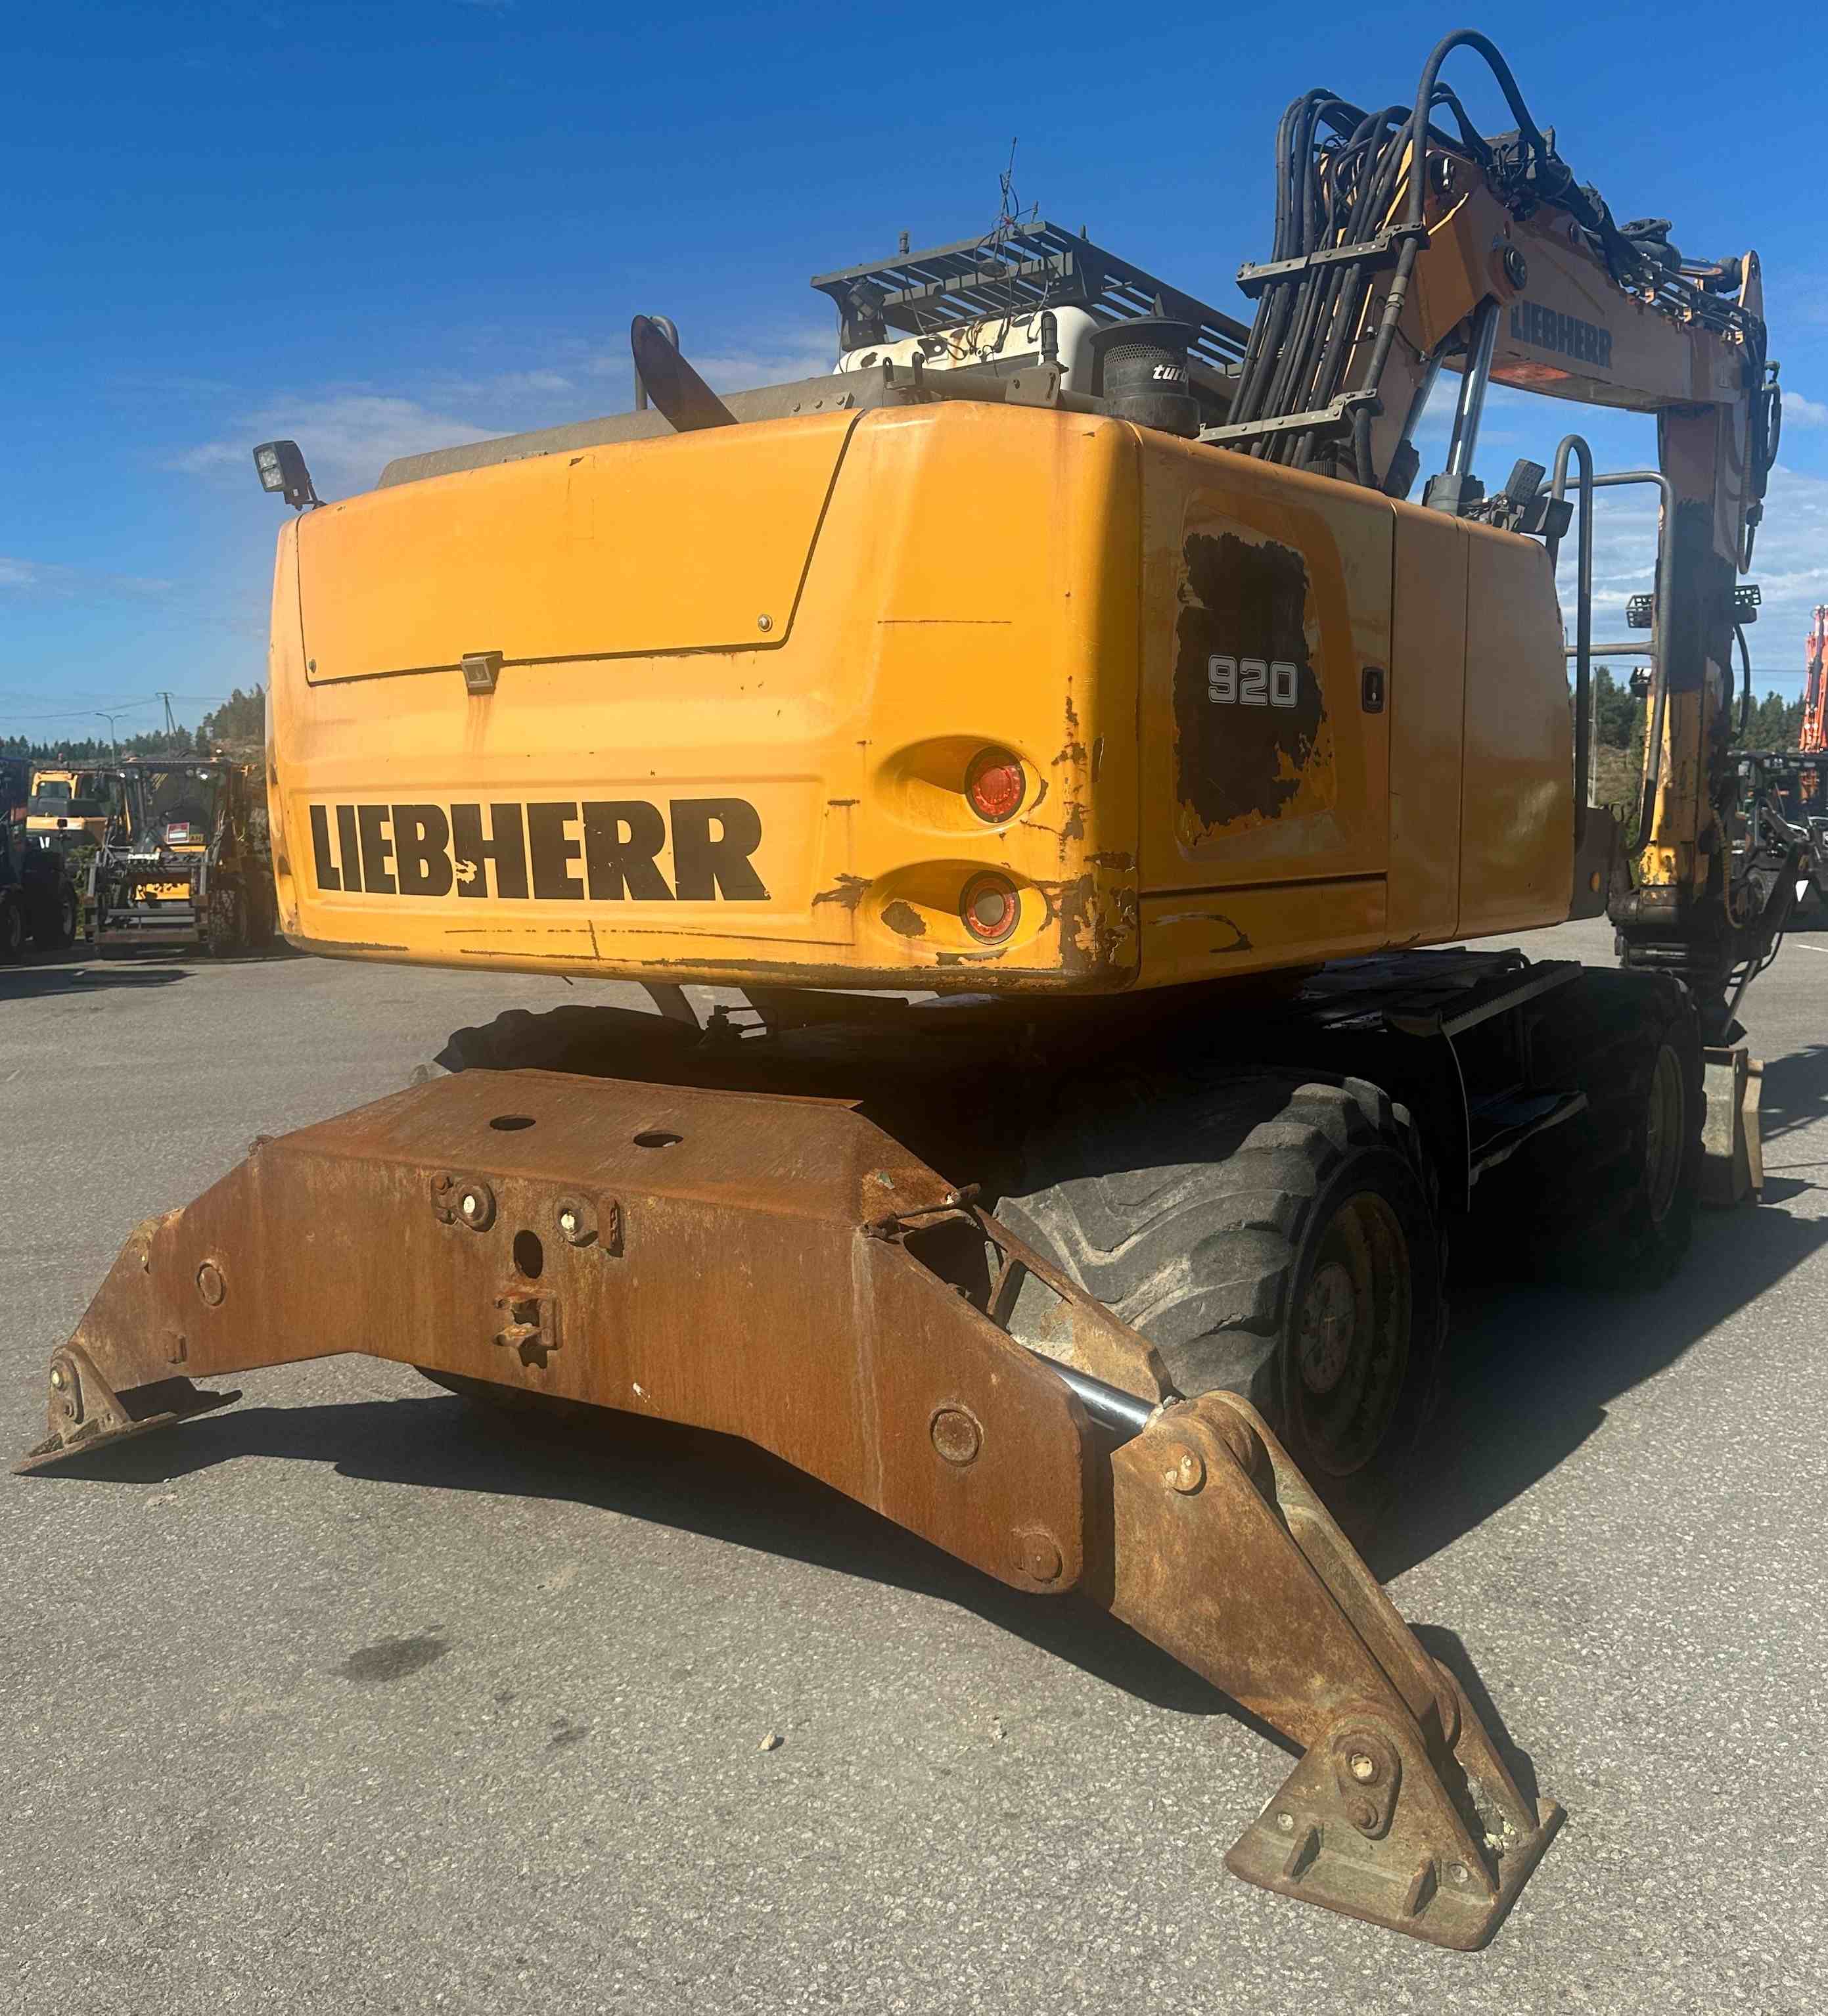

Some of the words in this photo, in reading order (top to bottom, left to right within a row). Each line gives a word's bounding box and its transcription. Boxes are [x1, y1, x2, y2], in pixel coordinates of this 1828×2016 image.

[1511, 300, 1614, 369] LIEBHERR
[1208, 655, 1298, 708] 920
[309, 798, 772, 900] LIEBHERR
